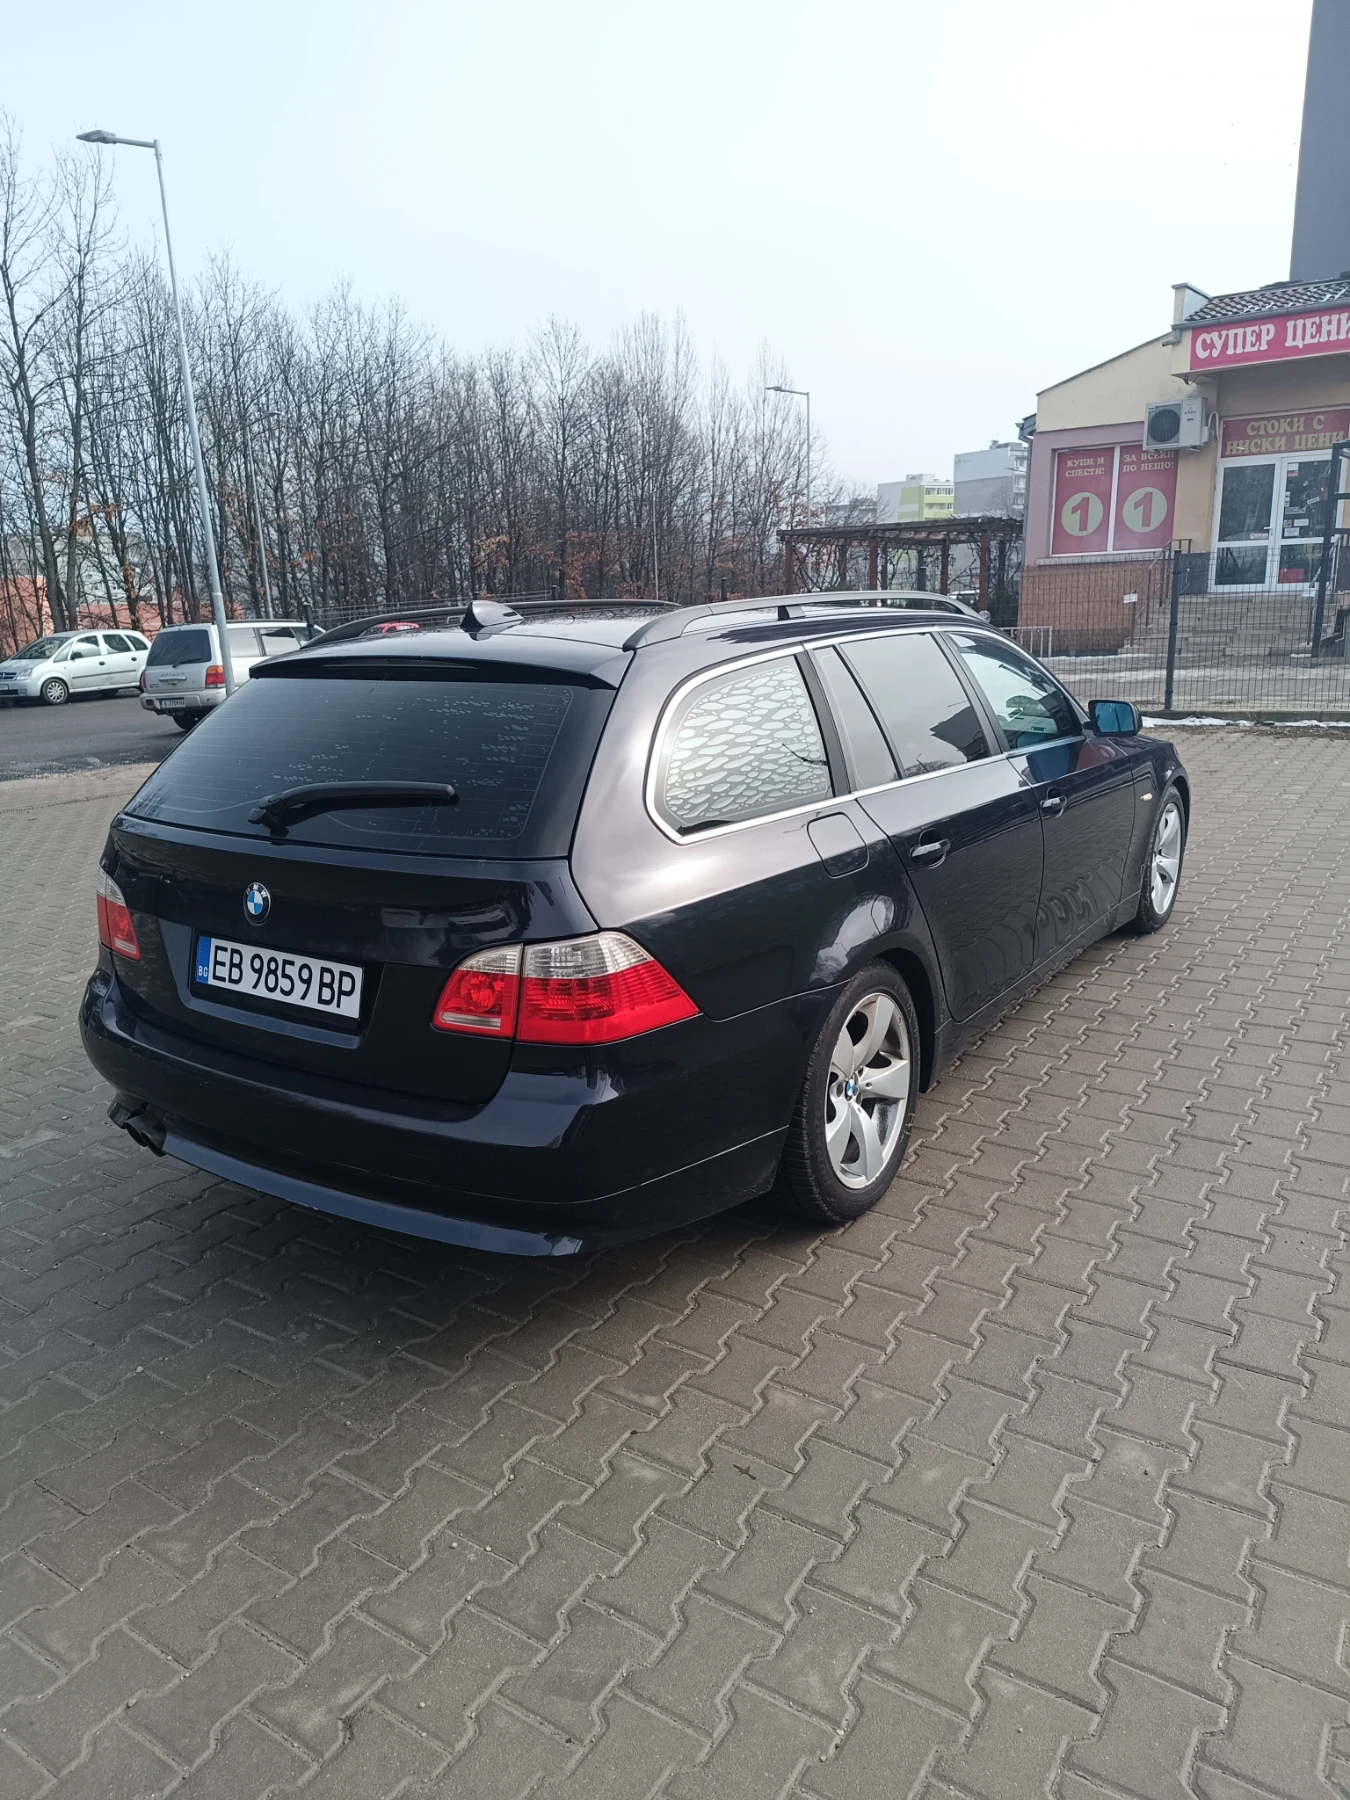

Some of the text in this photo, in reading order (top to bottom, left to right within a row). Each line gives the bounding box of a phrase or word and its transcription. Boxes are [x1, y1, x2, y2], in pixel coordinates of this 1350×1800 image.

[1195, 323, 1275, 359] СУПЕР
[1247, 415, 1325, 436] СТОКИ С
[1225, 436, 1287, 456] НИСКИ
[1066, 458, 1093, 468] КУПИ
[1123, 454, 1137, 462] ЗА
[1123, 461, 1174, 473] ПО НЕЩО!
[1065, 467, 1105, 478] СПЕСТИ!
[1071, 496, 1090, 532] 1
[1133, 491, 1154, 528] 1
[198, 965, 209, 978] BG
[212, 945, 356, 1009] EB 9859 BP
